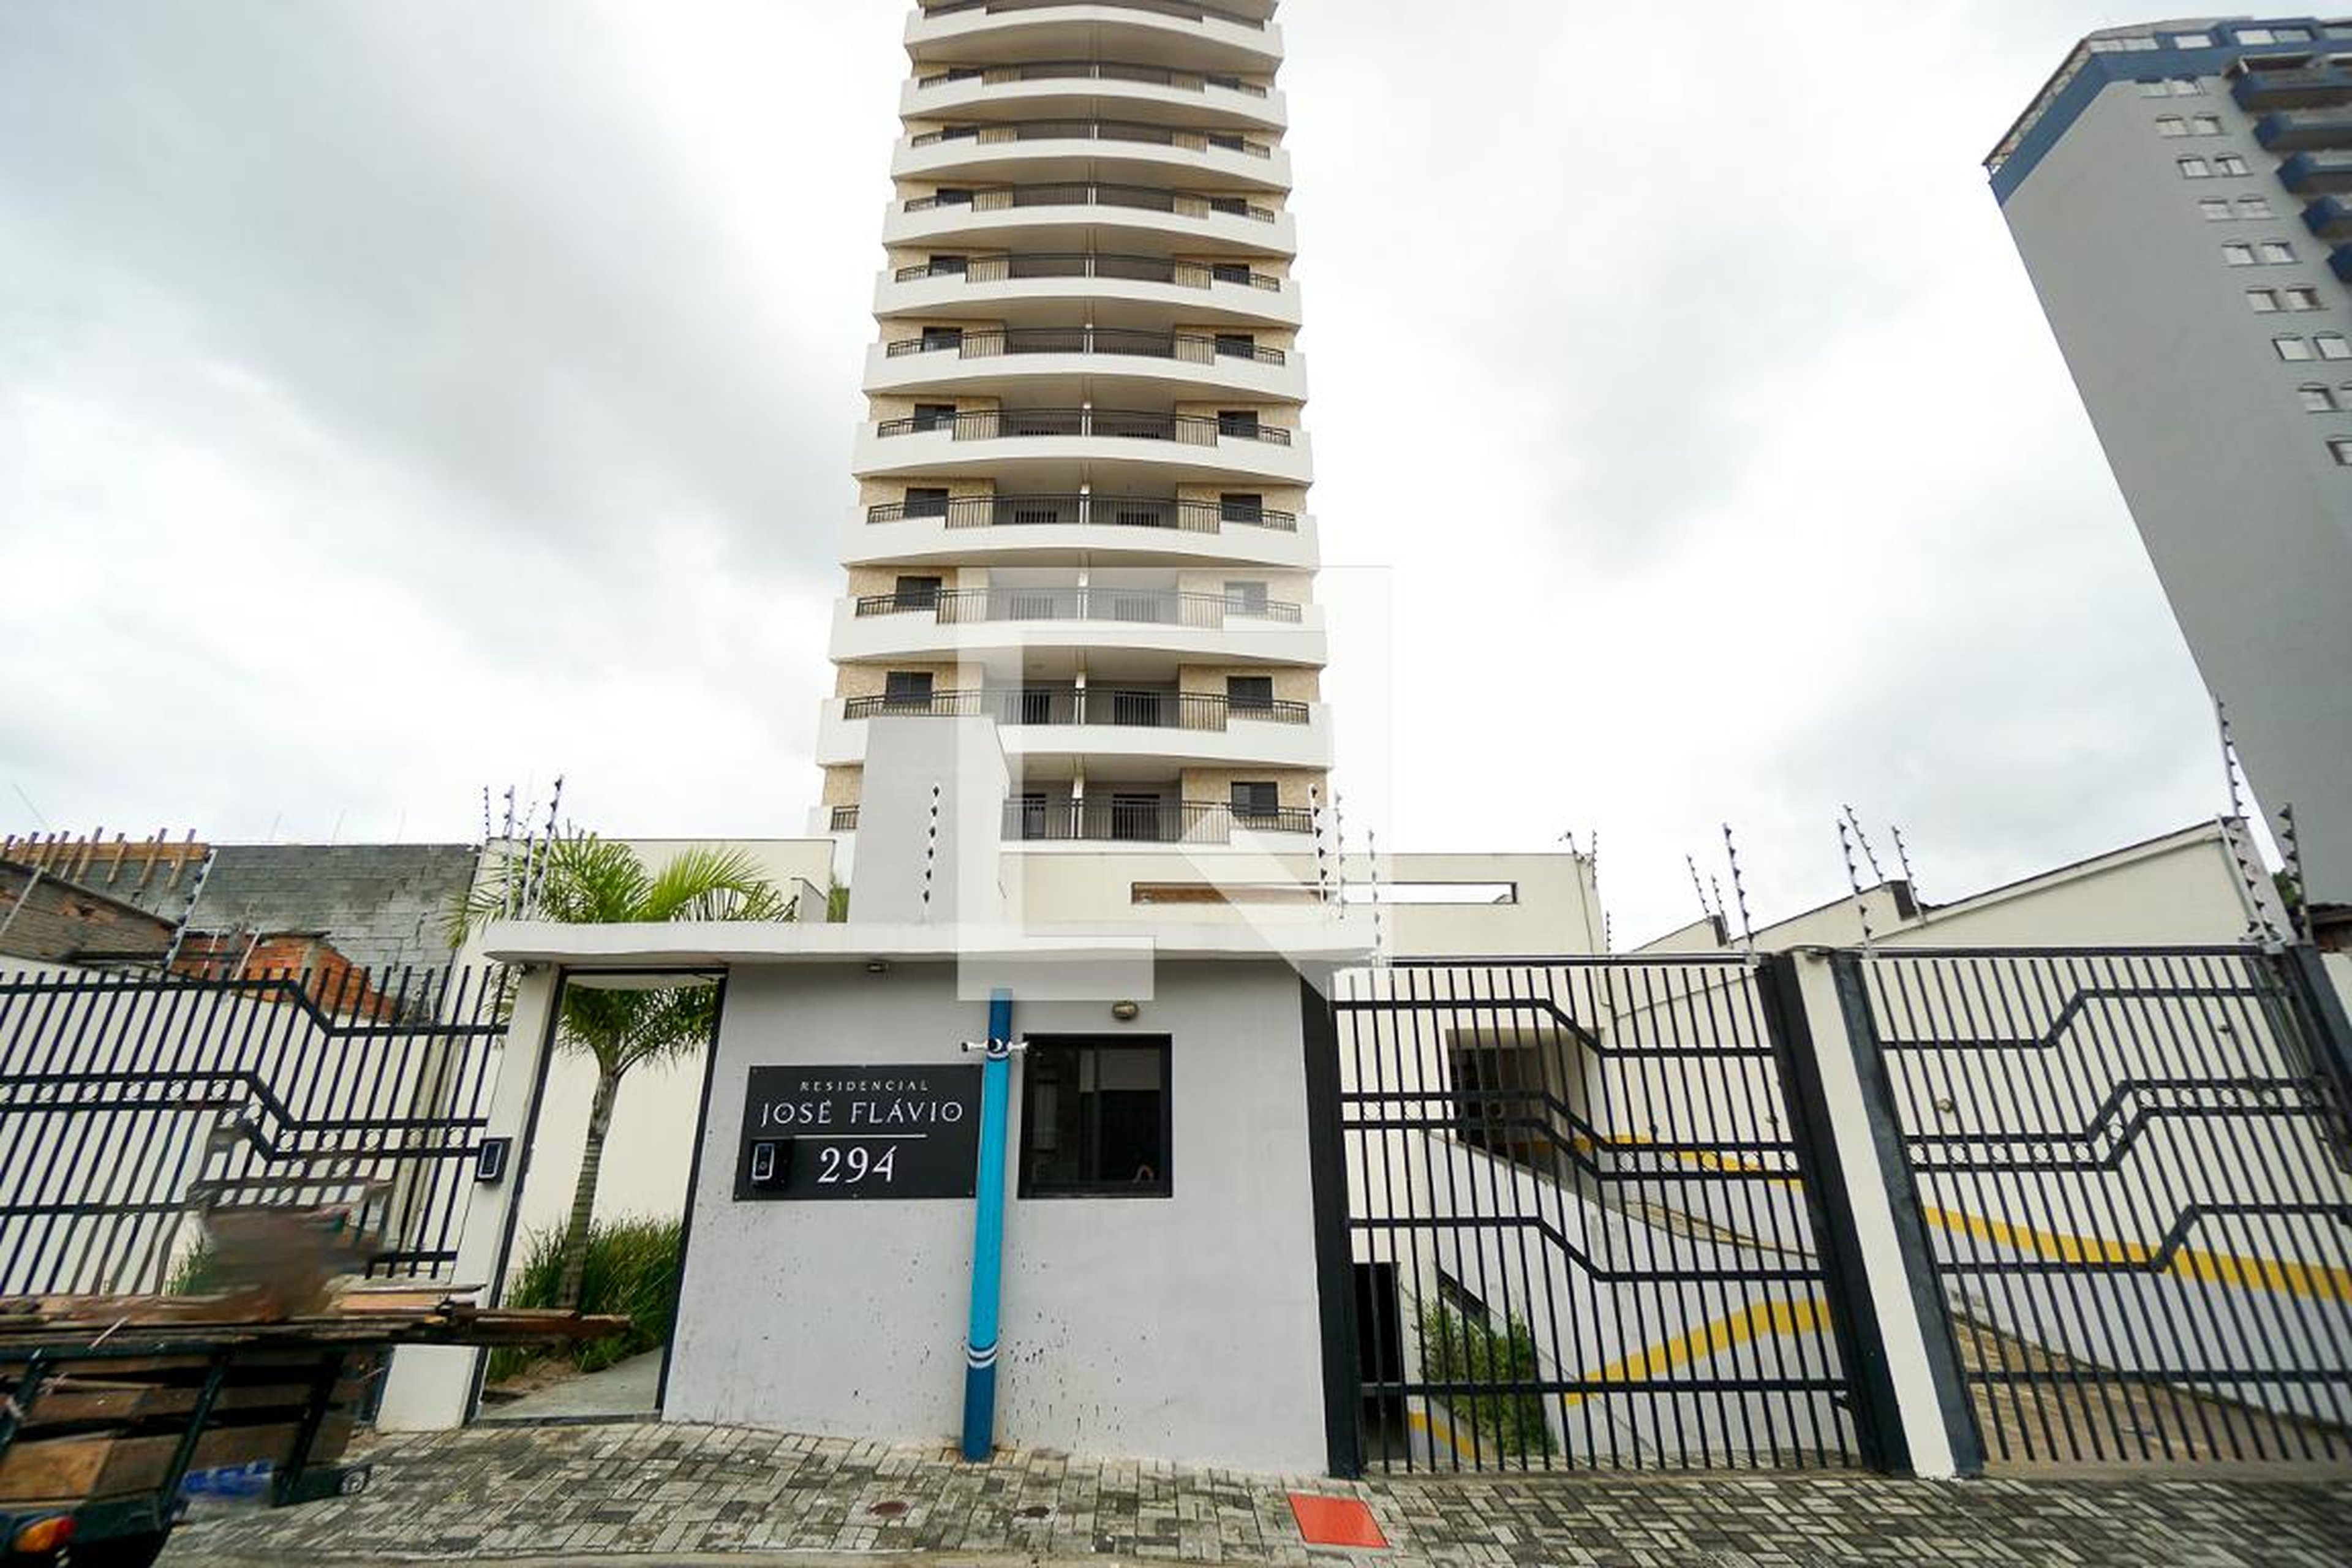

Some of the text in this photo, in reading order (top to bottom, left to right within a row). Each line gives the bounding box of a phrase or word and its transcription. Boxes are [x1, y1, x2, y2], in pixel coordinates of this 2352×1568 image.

[799, 1081, 929, 1091] RESIDENCIAL
[761, 1098, 963, 1127] JOSÉ FLÁVIO
[817, 1145, 898, 1183] 294
